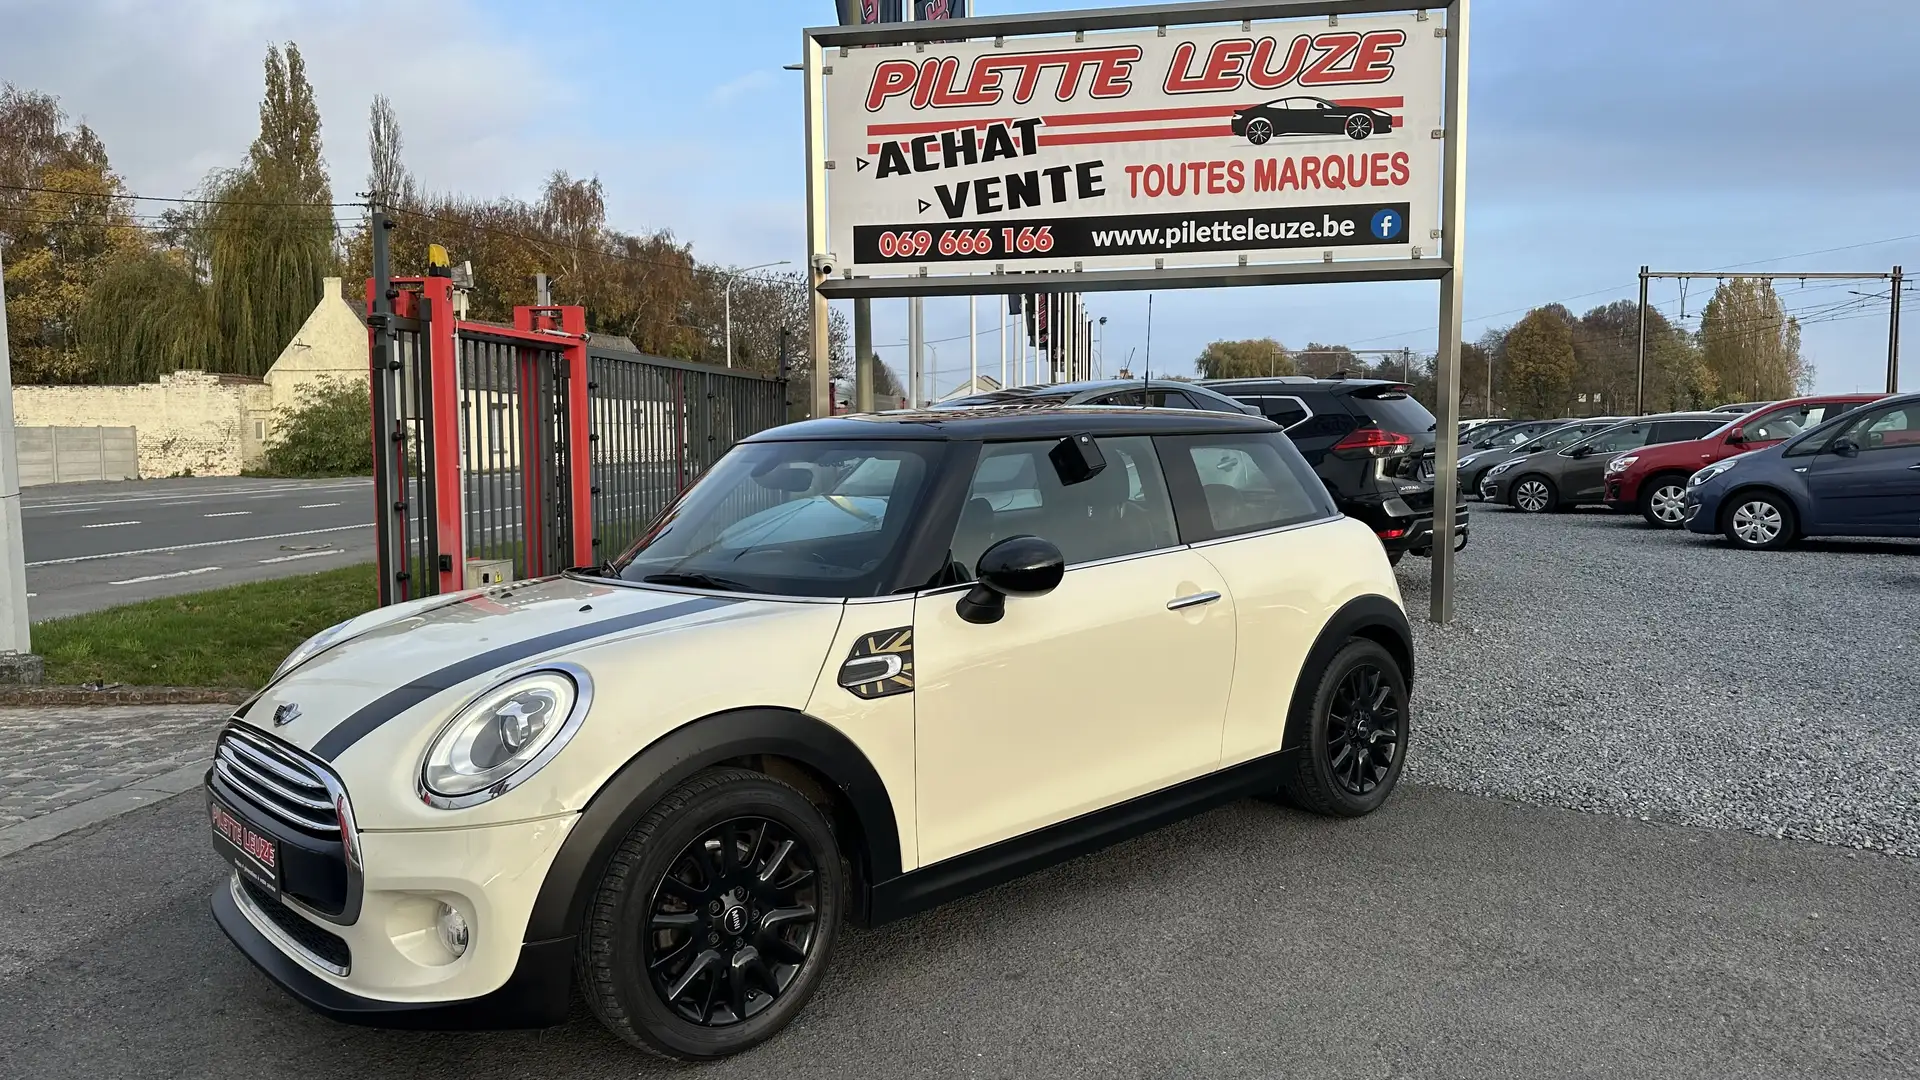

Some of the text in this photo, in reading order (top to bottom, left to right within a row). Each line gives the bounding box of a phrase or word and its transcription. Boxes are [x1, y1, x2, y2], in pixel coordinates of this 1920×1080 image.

[865, 29, 1406, 112] PILETTE LEUZE
[875, 117, 1043, 179] ACHAT
[934, 160, 1106, 219] VENTE
[1124, 151, 1411, 199] TOUTES MARQUES
[878, 226, 1054, 257] 069 666 166
[1091, 213, 1356, 249] www.piletteleuze.be
[212, 802, 275, 868] PILETTE LEUZE
[731, 909, 741, 930] MINI
